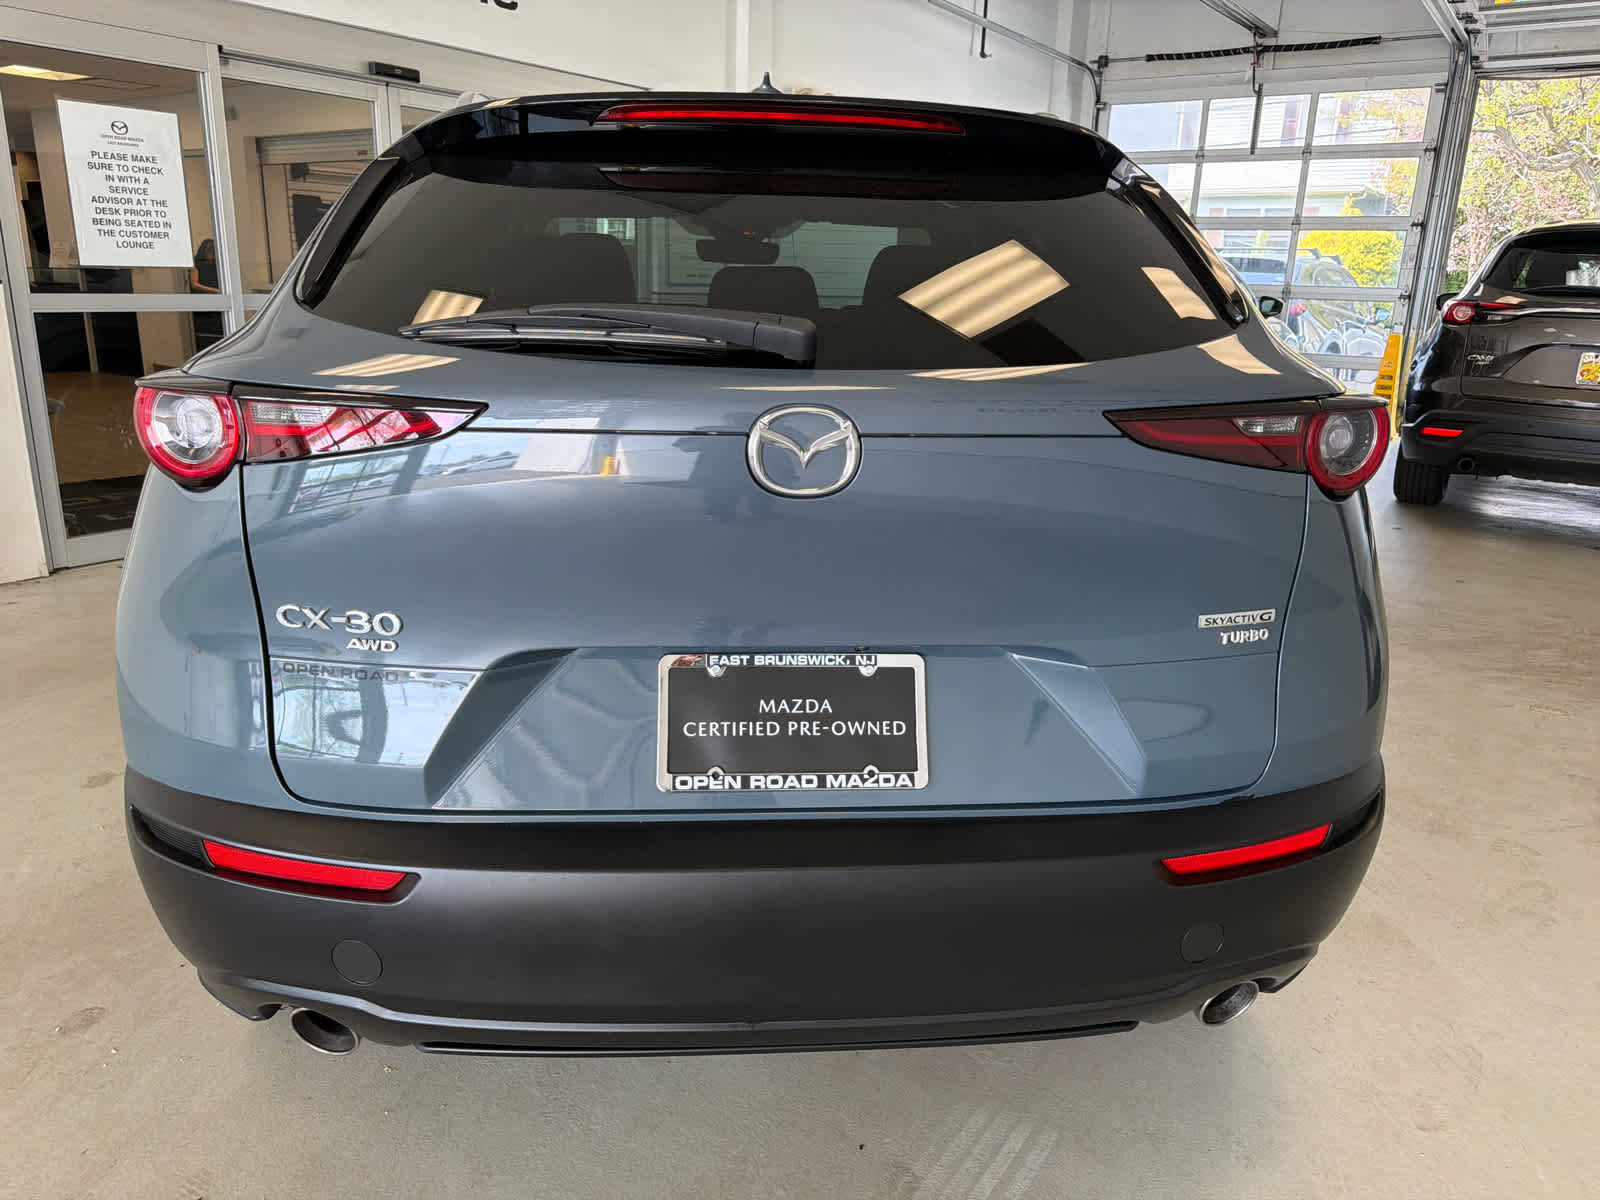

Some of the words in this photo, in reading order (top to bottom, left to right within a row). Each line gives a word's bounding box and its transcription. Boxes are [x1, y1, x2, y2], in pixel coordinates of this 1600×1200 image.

[91, 150, 129, 162] PLEASE
[131, 153, 158, 164] MAKE
[87, 162, 114, 172] SURE
[117, 164, 129, 172] TO
[131, 166, 164, 175] CHECK
[105, 174, 115, 182] IN
[117, 175, 141, 185] WITH
[143, 177, 150, 185] A
[108, 185, 149, 196] SERVICE
[91, 195, 134, 206] ADVISOR
[136, 198, 149, 206] AT
[150, 199, 168, 207] THE
[95, 207, 121, 216] DESK
[123, 208, 152, 217] PRIOR
[153, 209, 167, 218] TO
[92, 218, 122, 227] BEING
[124, 219, 161, 229] SEATED
[162, 221, 172, 229] IN
[97, 228, 117, 238] THE
[118, 230, 170, 240] CUSTOMER
[116, 240, 156, 250] LOUNGE
[275, 603, 403, 637] CX-30
[1220, 627, 1269, 645] TURBO
[346, 638, 398, 653] AWD
[709, 655, 750, 666] EAST
[855, 654, 876, 666] NJ
[282, 662, 336, 677] OPEN
[340, 667, 399, 682] ROAD
[758, 699, 833, 713] MAZDA
[683, 722, 780, 737] CERTIFIED
[788, 720, 906, 736] PRE-OWNED
[674, 774, 742, 790] OPEN
[749, 774, 818, 789] ROAD
[826, 772, 913, 788] MAZDA
